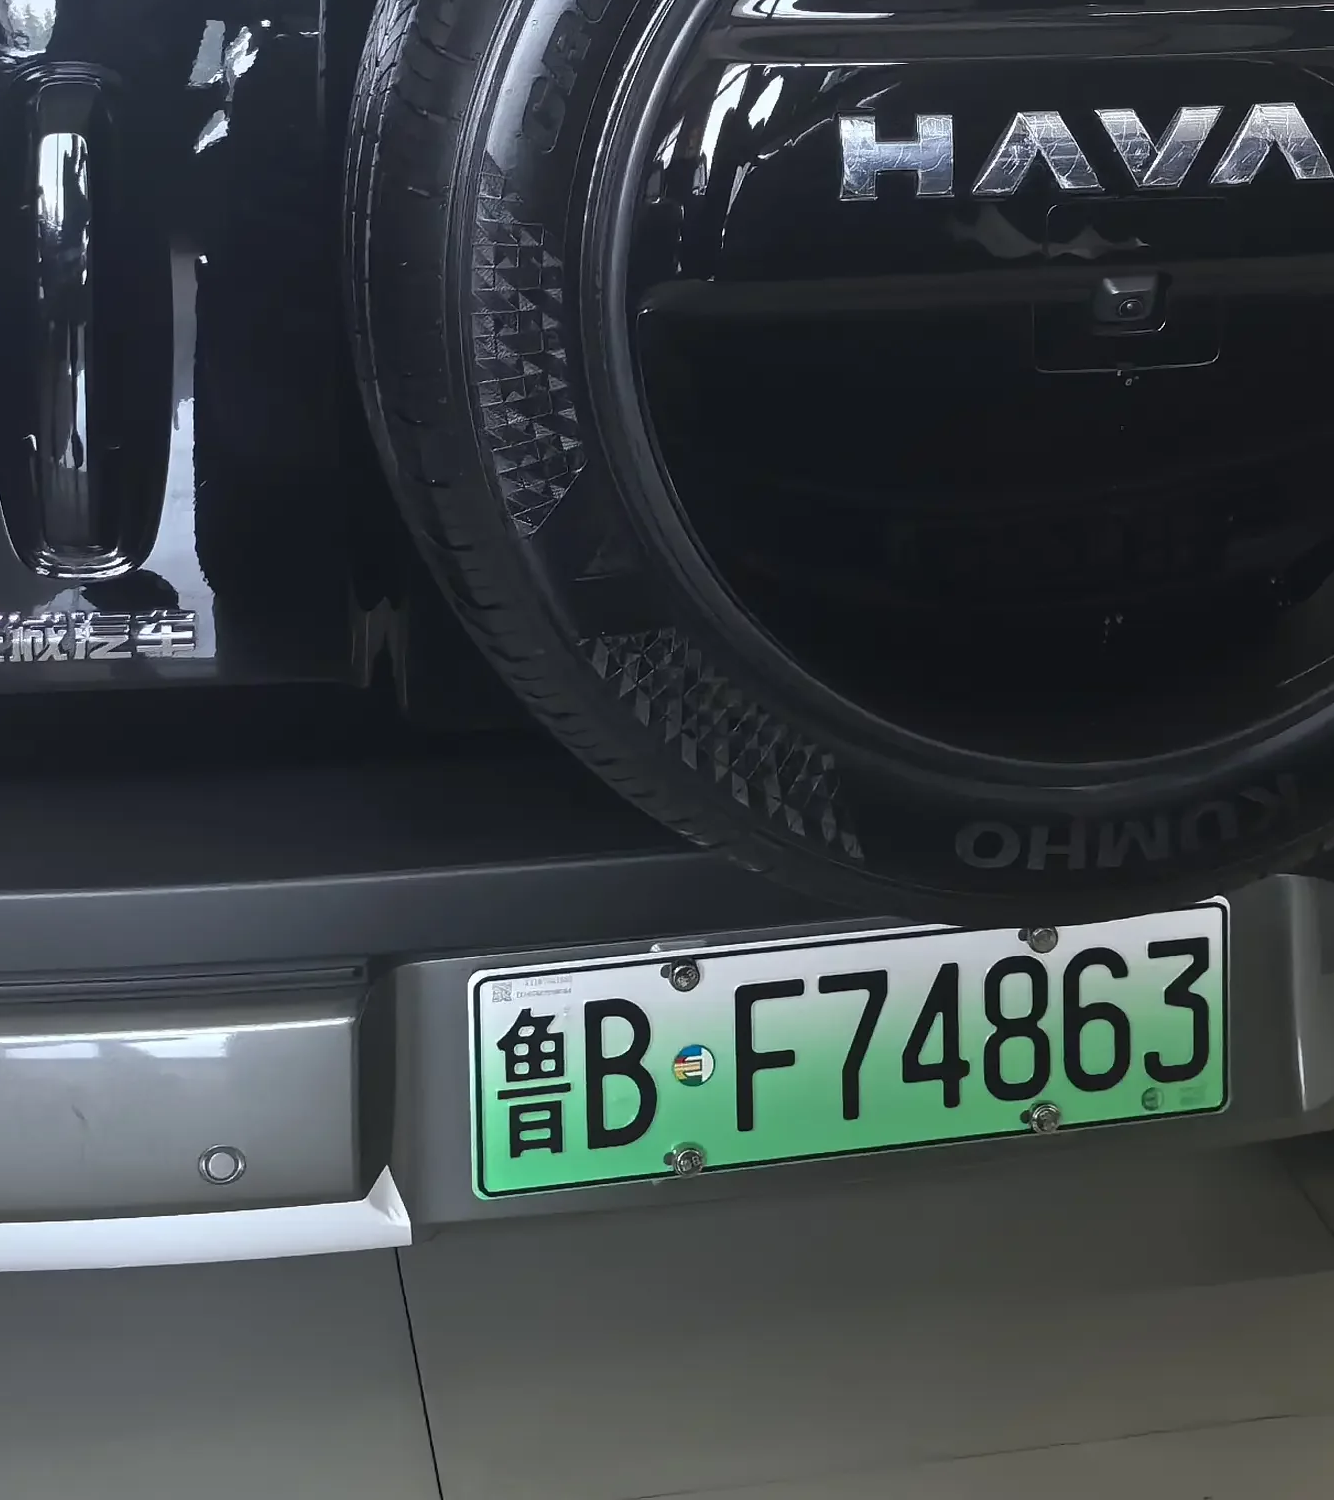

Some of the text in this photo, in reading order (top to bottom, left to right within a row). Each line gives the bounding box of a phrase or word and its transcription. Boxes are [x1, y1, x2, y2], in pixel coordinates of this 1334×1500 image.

[953, 772, 1303, 873] KUMHO
[496, 935, 1212, 1160] 鲁B F74863
